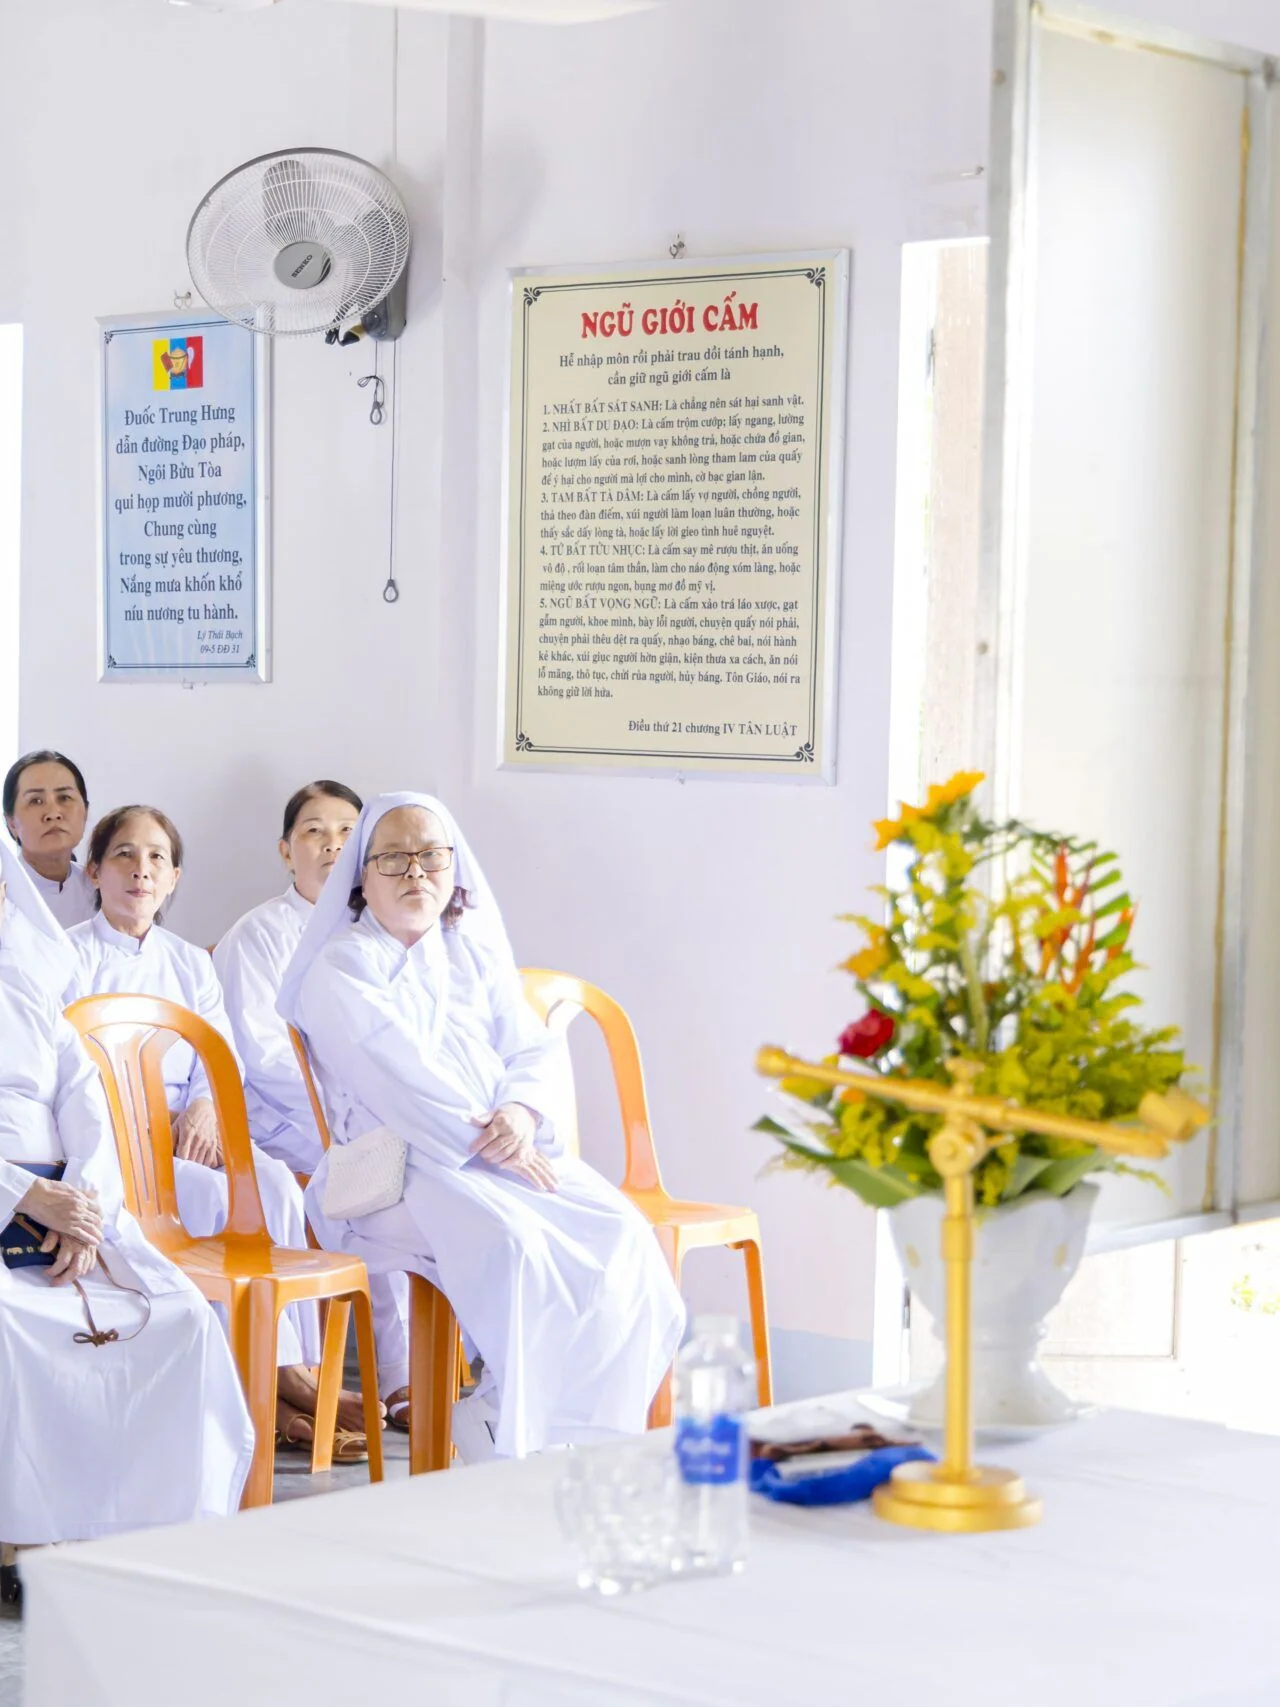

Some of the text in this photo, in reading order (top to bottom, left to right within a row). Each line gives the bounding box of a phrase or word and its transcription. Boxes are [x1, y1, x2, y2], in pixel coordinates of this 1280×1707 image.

[291, 254, 313, 278] SENKO
[641, 298, 695, 335] GIỚI
[702, 289, 758, 332] CẤM
[576, 352, 603, 369] nhập
[606, 351, 629, 365] môn
[632, 348, 647, 364] rồi
[650, 349, 674, 365] phải
[677, 350, 700, 361] trau
[703, 344, 721, 360] dồi
[723, 345, 749, 359] tánh
[752, 343, 784, 361] hạnh,
[607, 365, 730, 387] cần giữ ngũ giới cấm là
[124, 402, 235, 427] Đuốc Trung Hưng
[552, 399, 581, 415] NHẤT
[584, 398, 605, 413] BẤT
[607, 398, 628, 412] SÁT
[629, 399, 662, 412] SANH:
[665, 399, 677, 410] Là
[709, 396, 726, 408] nên
[728, 396, 742, 408] sát
[744, 395, 759, 410] hại
[761, 394, 784, 406] sanh
[786, 393, 804, 408] vật.
[542, 421, 549, 432] 2.
[573, 416, 594, 432] BẤT
[613, 418, 638, 433] ĐẠO:
[641, 417, 653, 429] Là
[655, 415, 674, 428] cấm
[676, 416, 699, 430] trộm
[744, 416, 775, 428] ngang,
[115, 430, 244, 457] dẫn đường Đạo pháp,
[138, 460, 221, 485] Ngôi Bửu Tòa
[560, 473, 574, 487] hại
[576, 473, 591, 484] cho
[593, 472, 618, 487] người
[620, 472, 634, 484] mà
[636, 472, 647, 486] lợi
[649, 472, 665, 483] cho
[667, 471, 693, 484] mình,
[707, 470, 724, 484] bạc
[726, 469, 745, 484] gian
[748, 469, 765, 483] lận.
[114, 488, 246, 514] qui họp mười phương,
[557, 509, 576, 520] theo
[578, 508, 596, 520] đàn
[598, 506, 623, 520] điếm,
[642, 507, 668, 521] người
[671, 507, 688, 518] làm
[691, 506, 711, 520] loạn
[714, 506, 735, 518] luân
[737, 505, 774, 520] thường,
[776, 505, 800, 519] hoặc
[143, 517, 216, 541] Chung cùng
[119, 545, 242, 569] trong sự yêu thương,
[120, 570, 242, 597] Nắng mưa khốn khổ
[124, 602, 238, 625] níu nương tu hành.
[539, 597, 547, 608] 5.
[575, 593, 597, 608] BẤT
[599, 597, 631, 610] VỌNG
[664, 598, 676, 609] Là
[678, 596, 698, 609] cấm
[701, 597, 718, 609] xảo
[737, 598, 752, 609] láo
[782, 600, 798, 612] gạt
[538, 632, 568, 646] chuyện
[570, 633, 589, 646] phải
[592, 633, 611, 644] thêu
[613, 633, 627, 647] dệt
[629, 636, 639, 645] ra
[667, 634, 690, 647] nhạo
[719, 634, 734, 646] chê
[756, 634, 771, 646] nói
[773, 635, 797, 647] hành
[628, 718, 797, 738] Điều thứ 21 chương IV TÂN LUẬT
